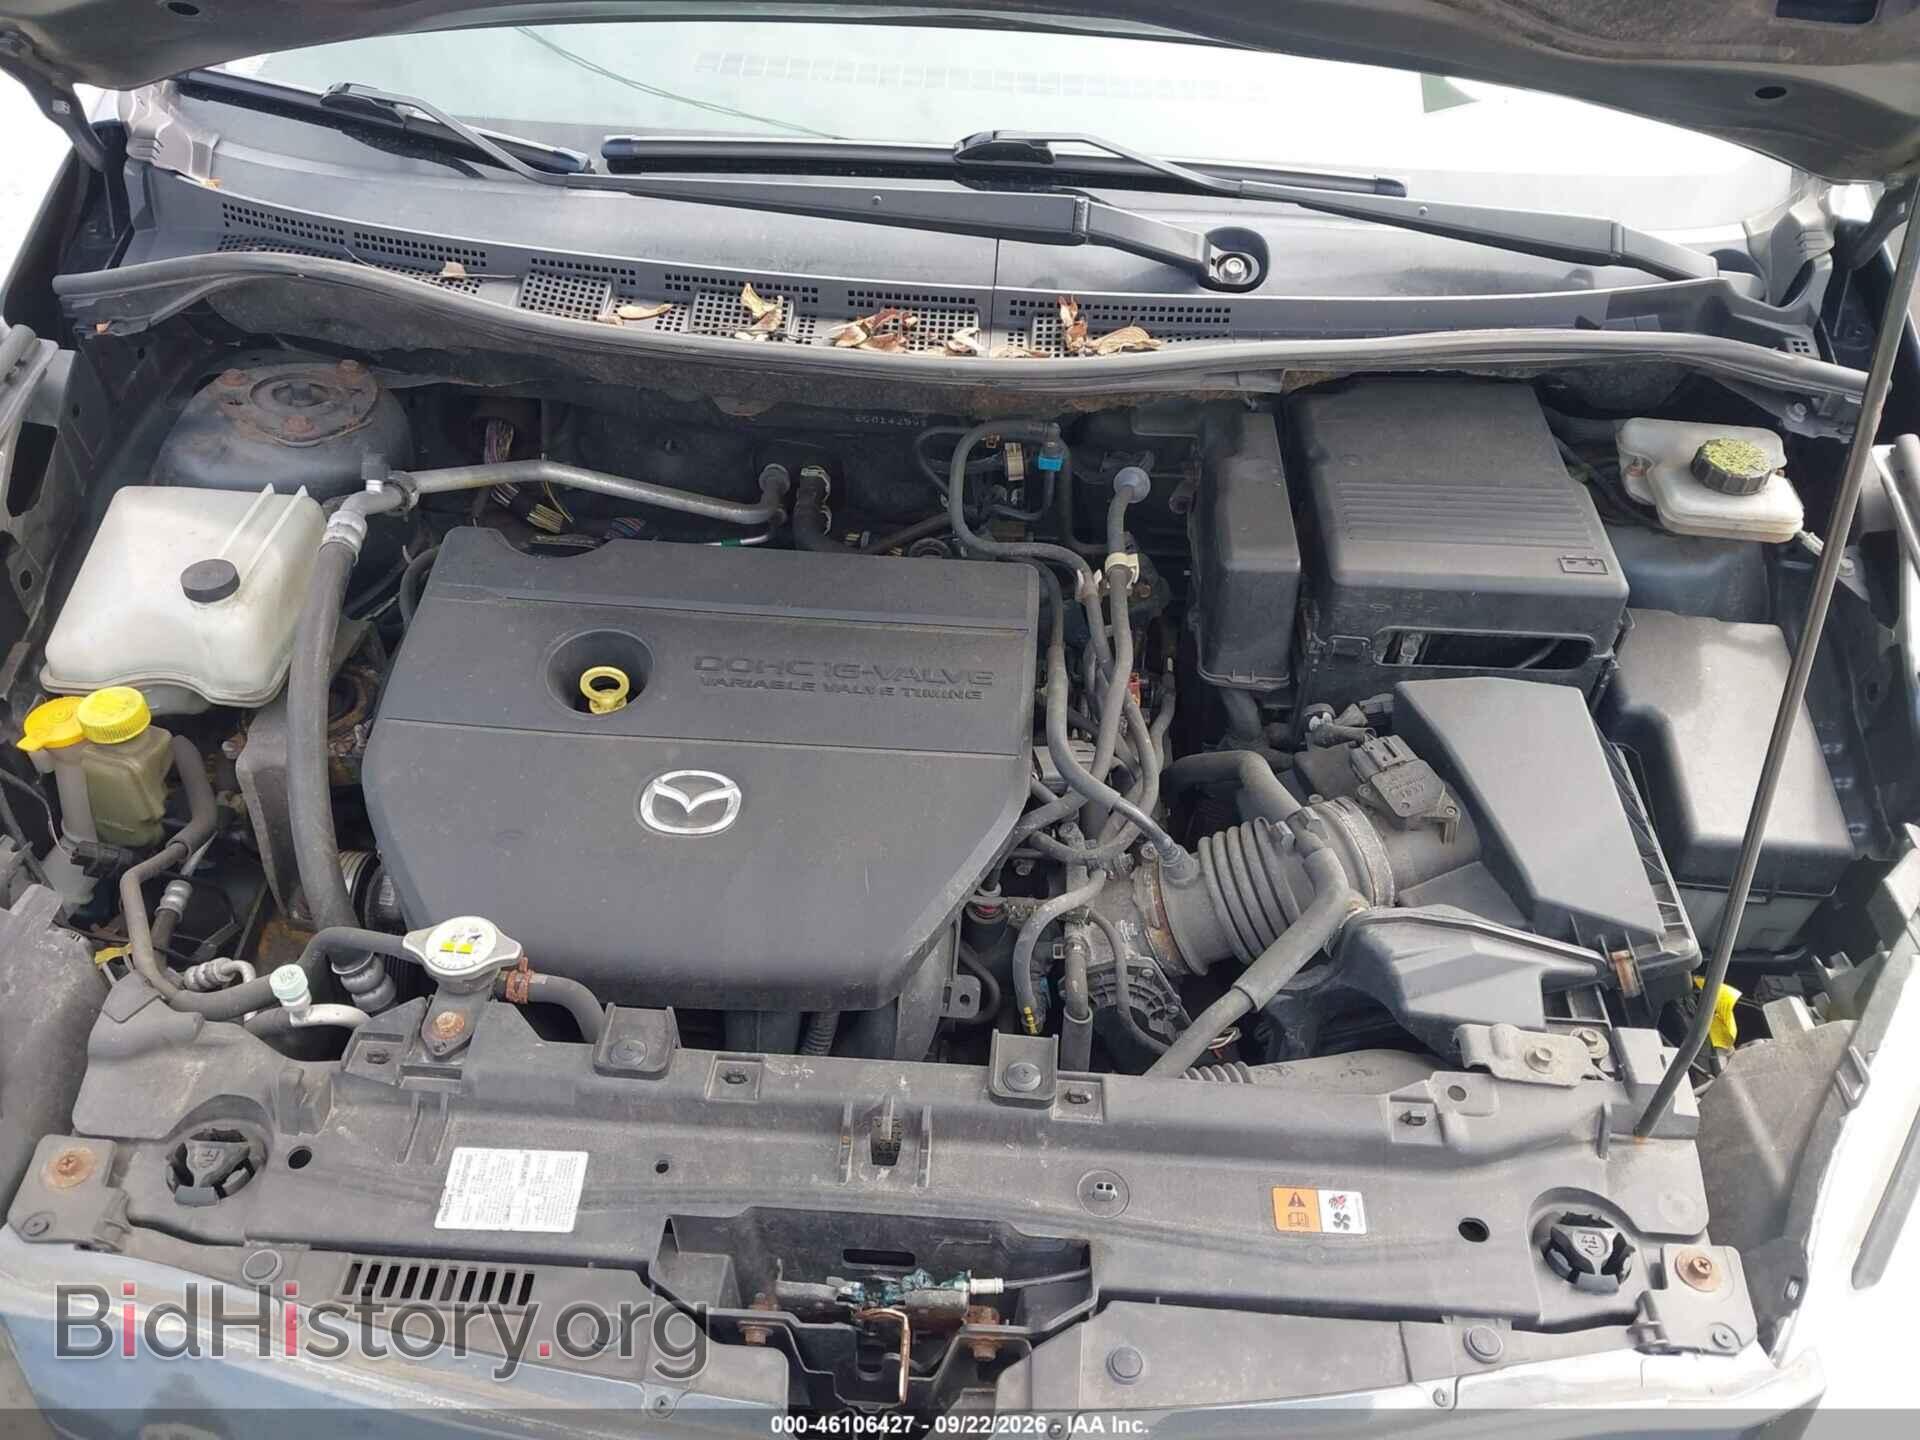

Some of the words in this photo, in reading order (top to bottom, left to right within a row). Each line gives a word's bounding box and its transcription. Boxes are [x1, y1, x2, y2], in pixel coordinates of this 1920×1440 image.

[694, 656, 816, 677] DOHC
[823, 661, 994, 687] 16-VALVE
[700, 677, 817, 693] VARIABLE
[823, 682, 896, 697] VALVE
[901, 686, 985, 700] TIMING
